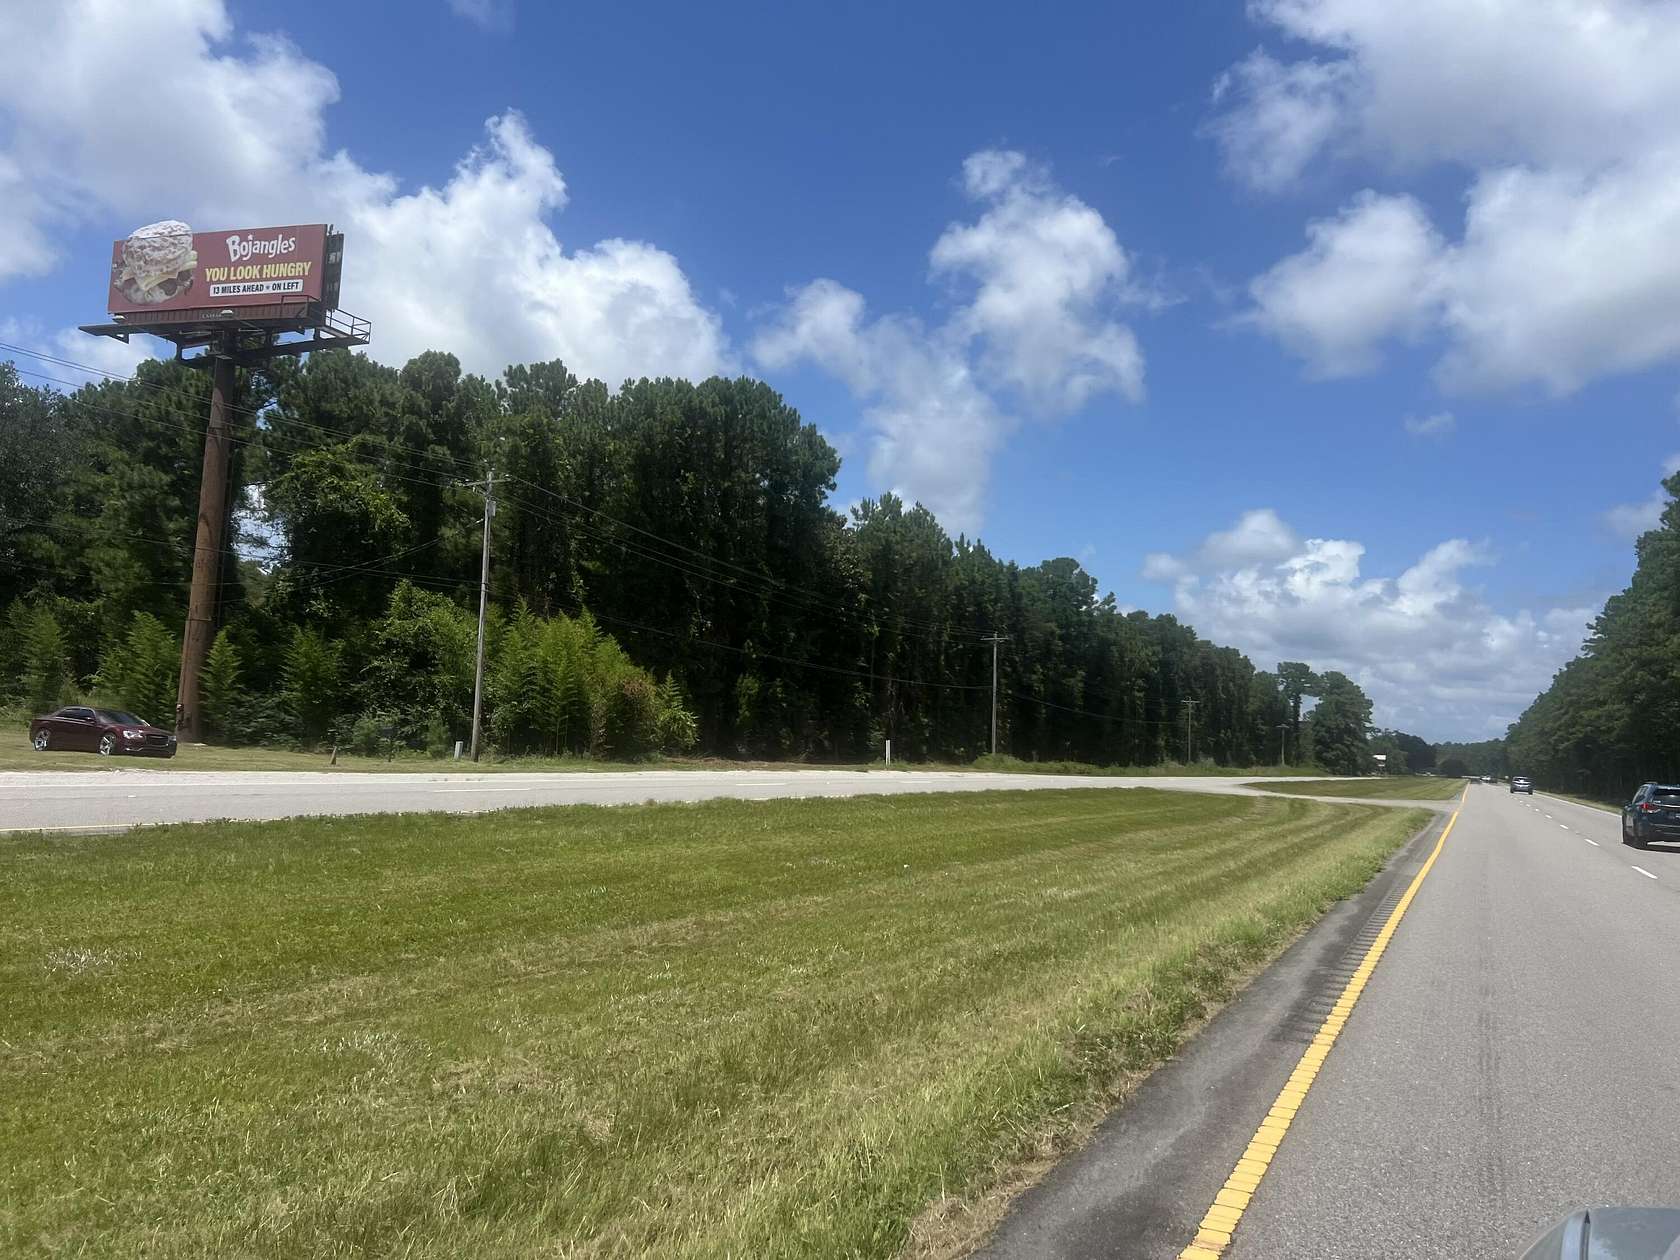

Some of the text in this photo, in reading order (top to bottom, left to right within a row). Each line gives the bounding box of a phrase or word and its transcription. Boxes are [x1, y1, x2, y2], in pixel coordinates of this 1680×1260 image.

[226, 234, 296, 262] Bojangles
[205, 261, 312, 282] YOU LOOK HUNGRY
[213, 281, 299, 295] 13 MILES AHEAD ON LEFT
